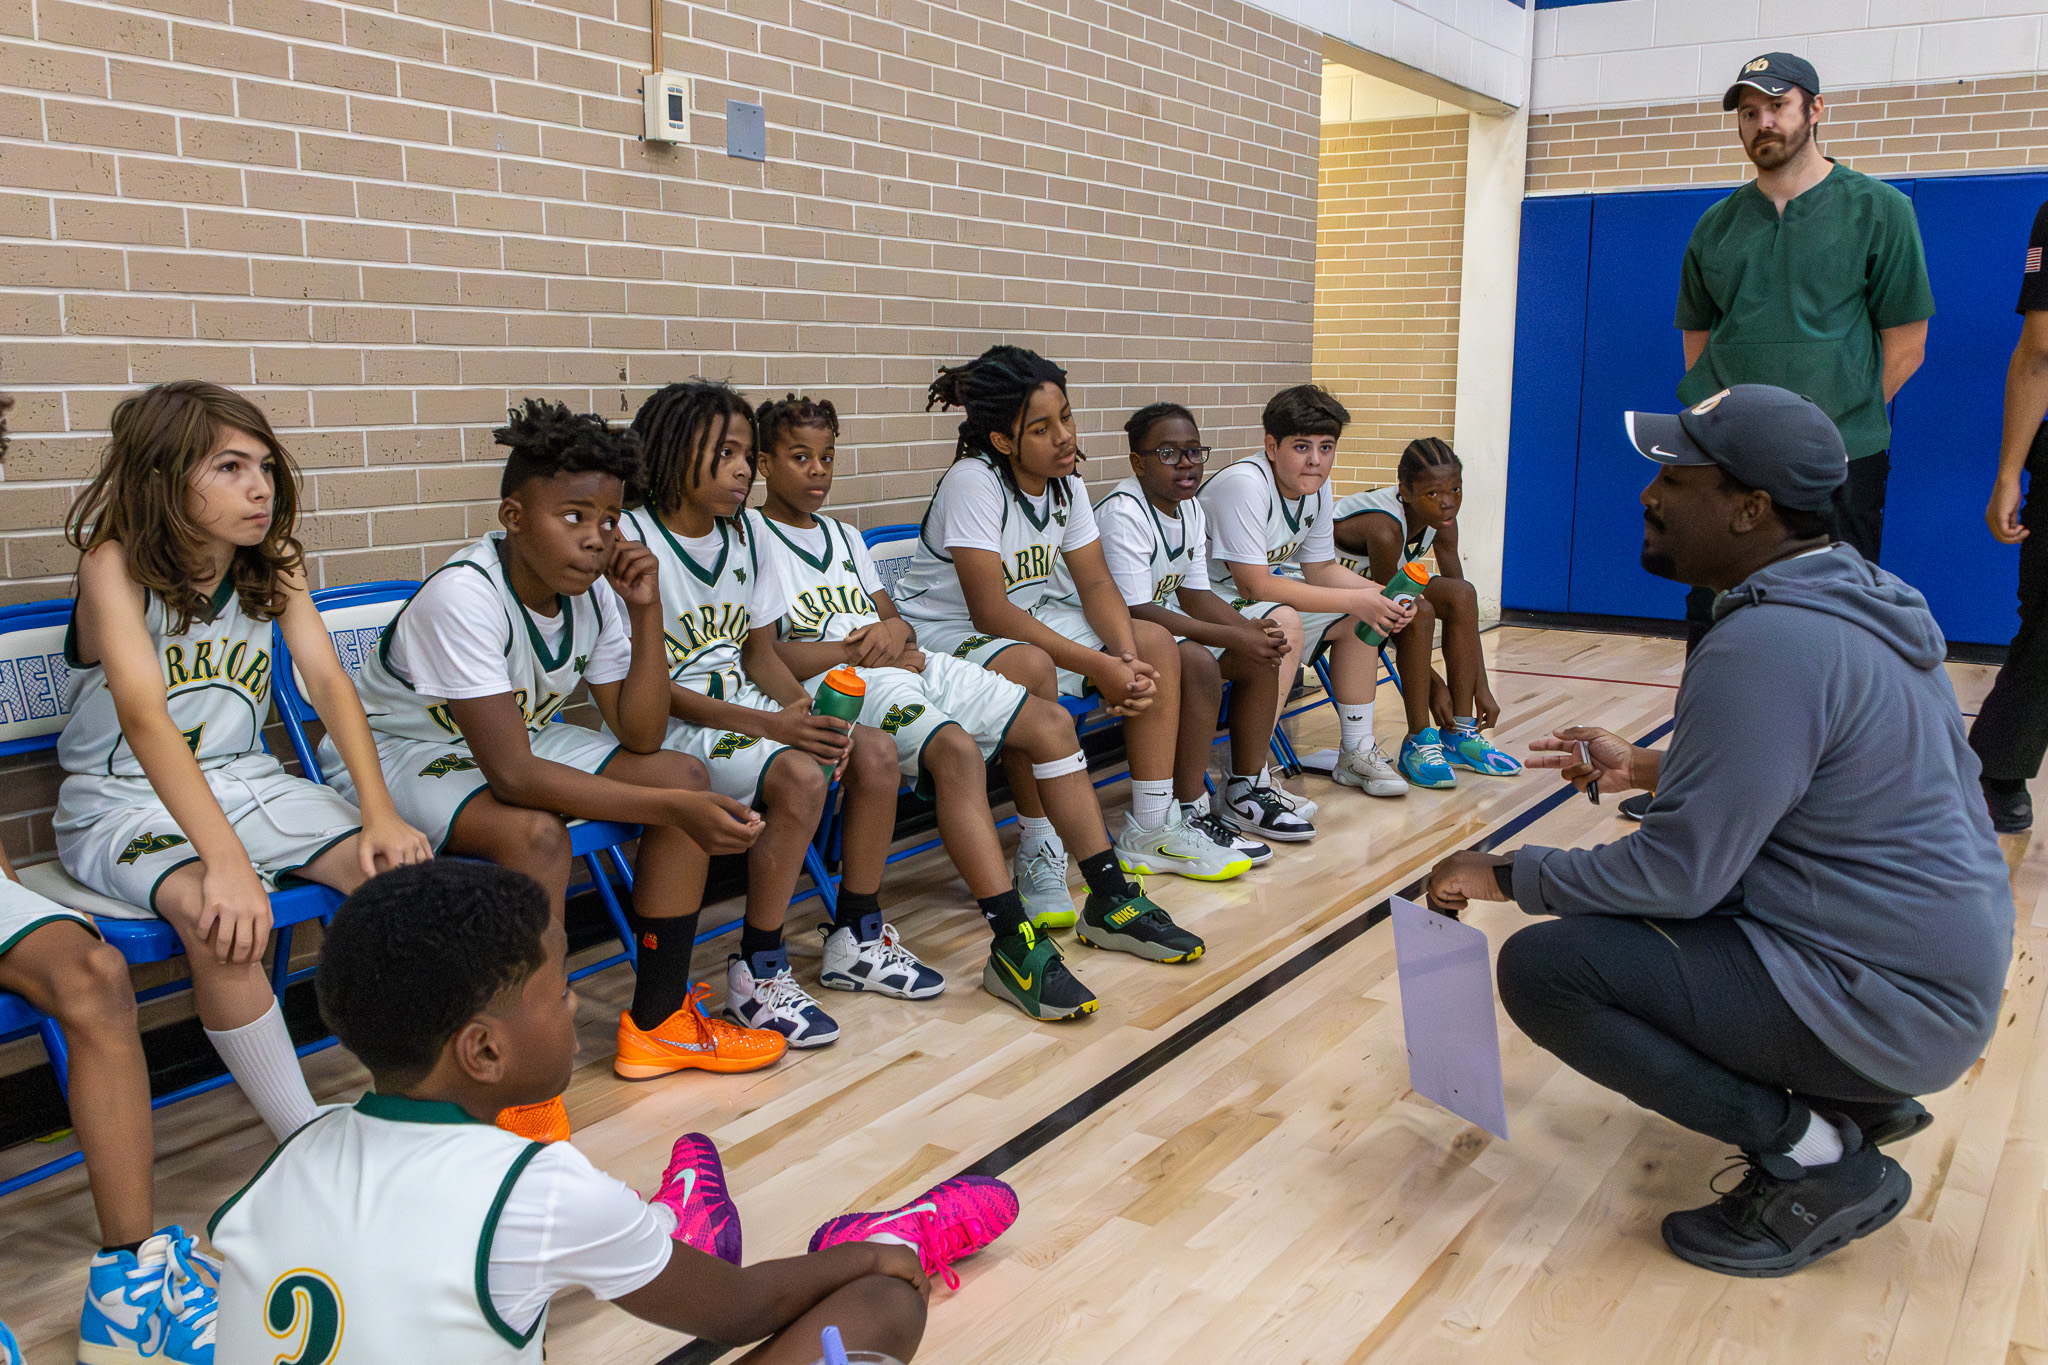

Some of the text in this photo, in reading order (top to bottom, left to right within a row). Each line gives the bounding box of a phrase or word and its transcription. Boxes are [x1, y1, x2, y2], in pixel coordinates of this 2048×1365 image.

[664, 602, 752, 668] ARRIO
[788, 584, 877, 640] WARRIO
[1110, 904, 1140, 925] NIKE
